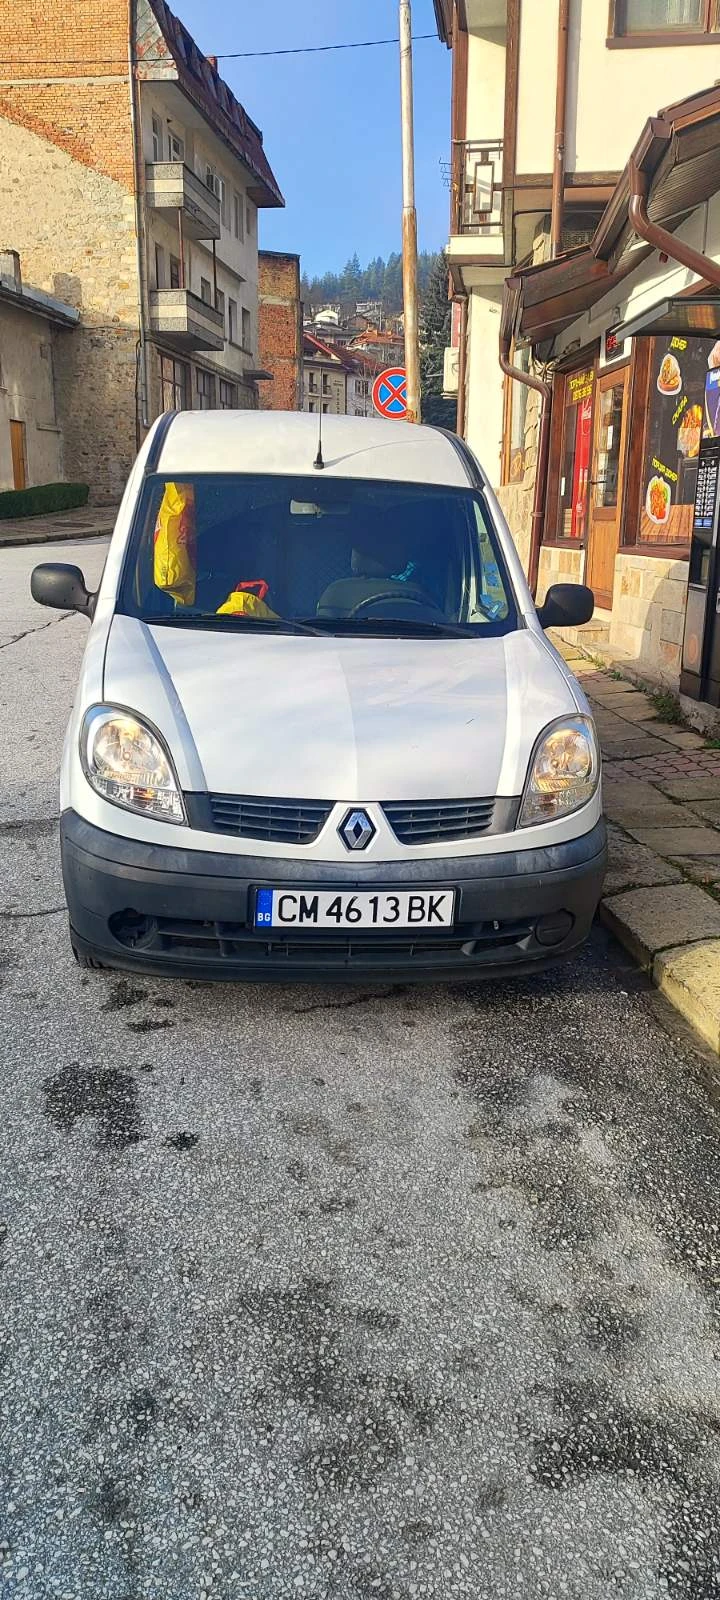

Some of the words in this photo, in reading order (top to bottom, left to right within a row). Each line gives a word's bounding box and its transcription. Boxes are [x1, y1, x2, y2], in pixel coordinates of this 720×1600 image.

[257, 912, 271, 922] BG
[278, 895, 318, 922] CM
[326, 896, 400, 923] 4613
[408, 896, 446, 922] BK
